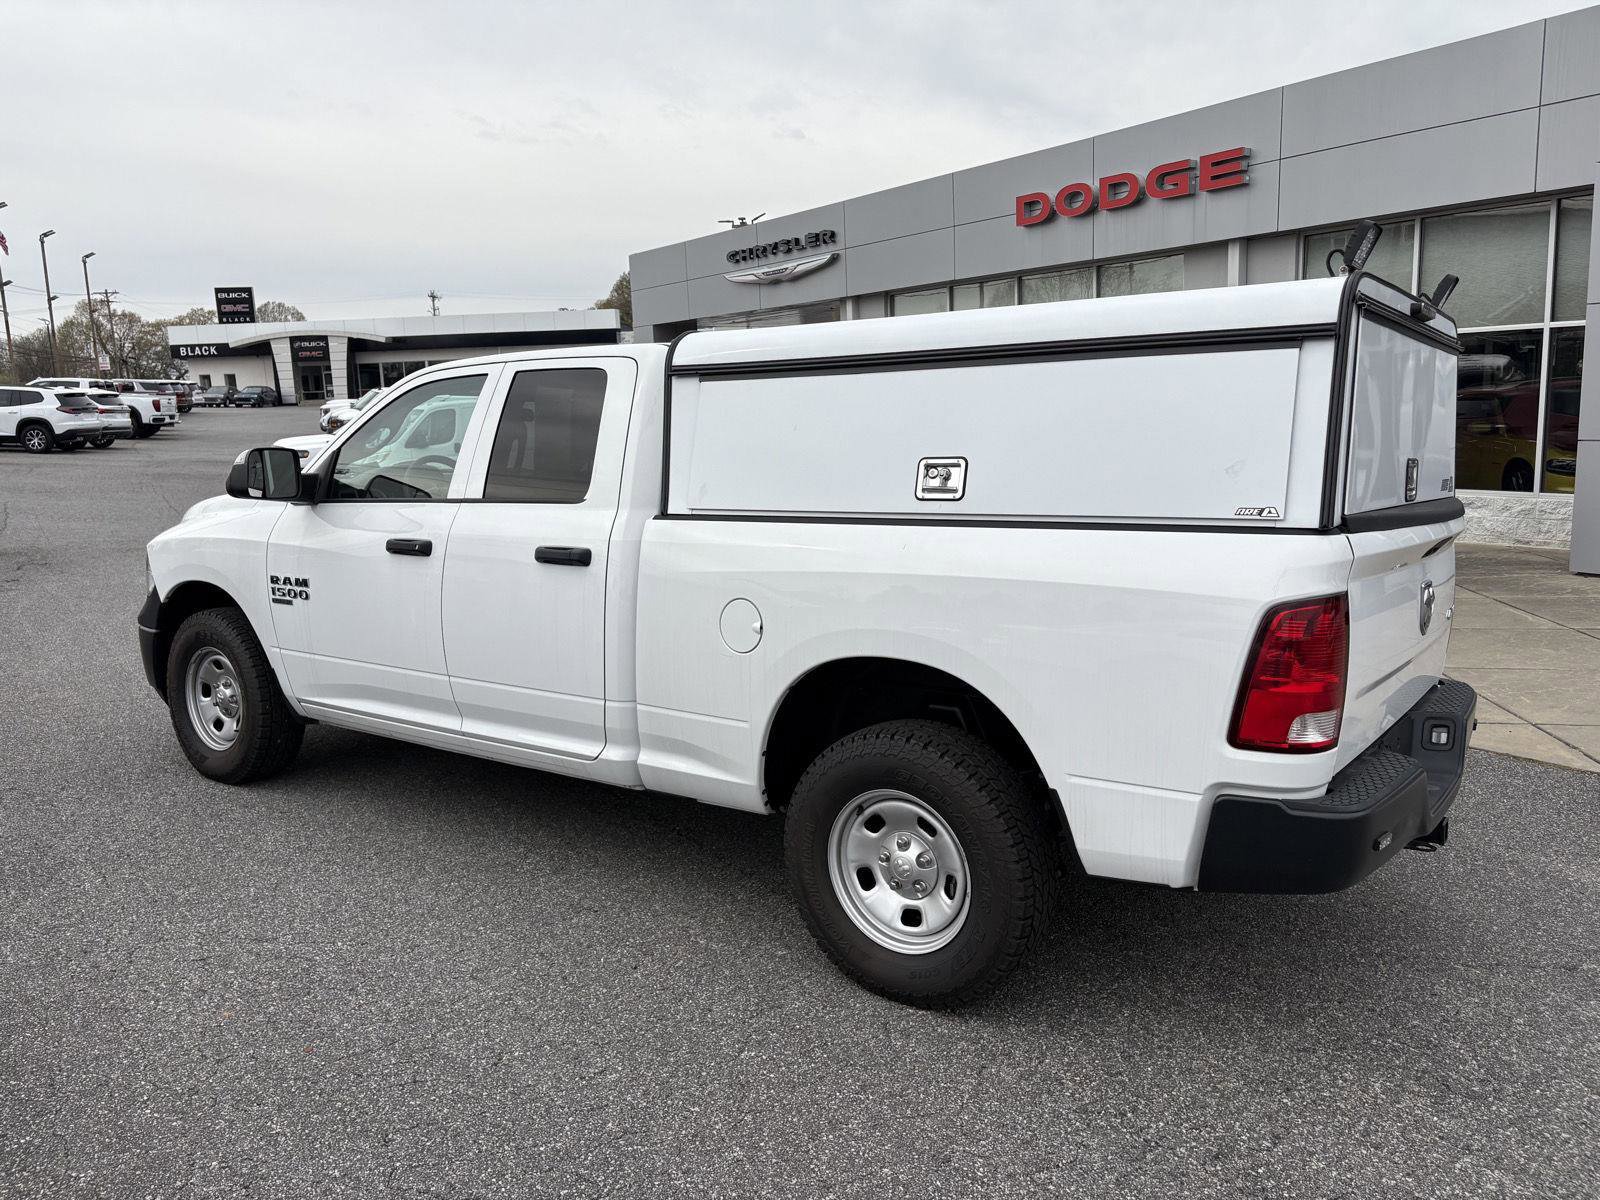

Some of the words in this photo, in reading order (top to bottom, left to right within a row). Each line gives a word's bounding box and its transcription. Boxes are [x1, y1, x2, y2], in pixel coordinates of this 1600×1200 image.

[1015, 146, 1252, 227] DODGE
[726, 229, 838, 264] CHRYSLER
[220, 304, 250, 312] GMC
[180, 345, 218, 356] BLACK
[270, 574, 310, 588] RAM
[271, 586, 311, 601] 1500
